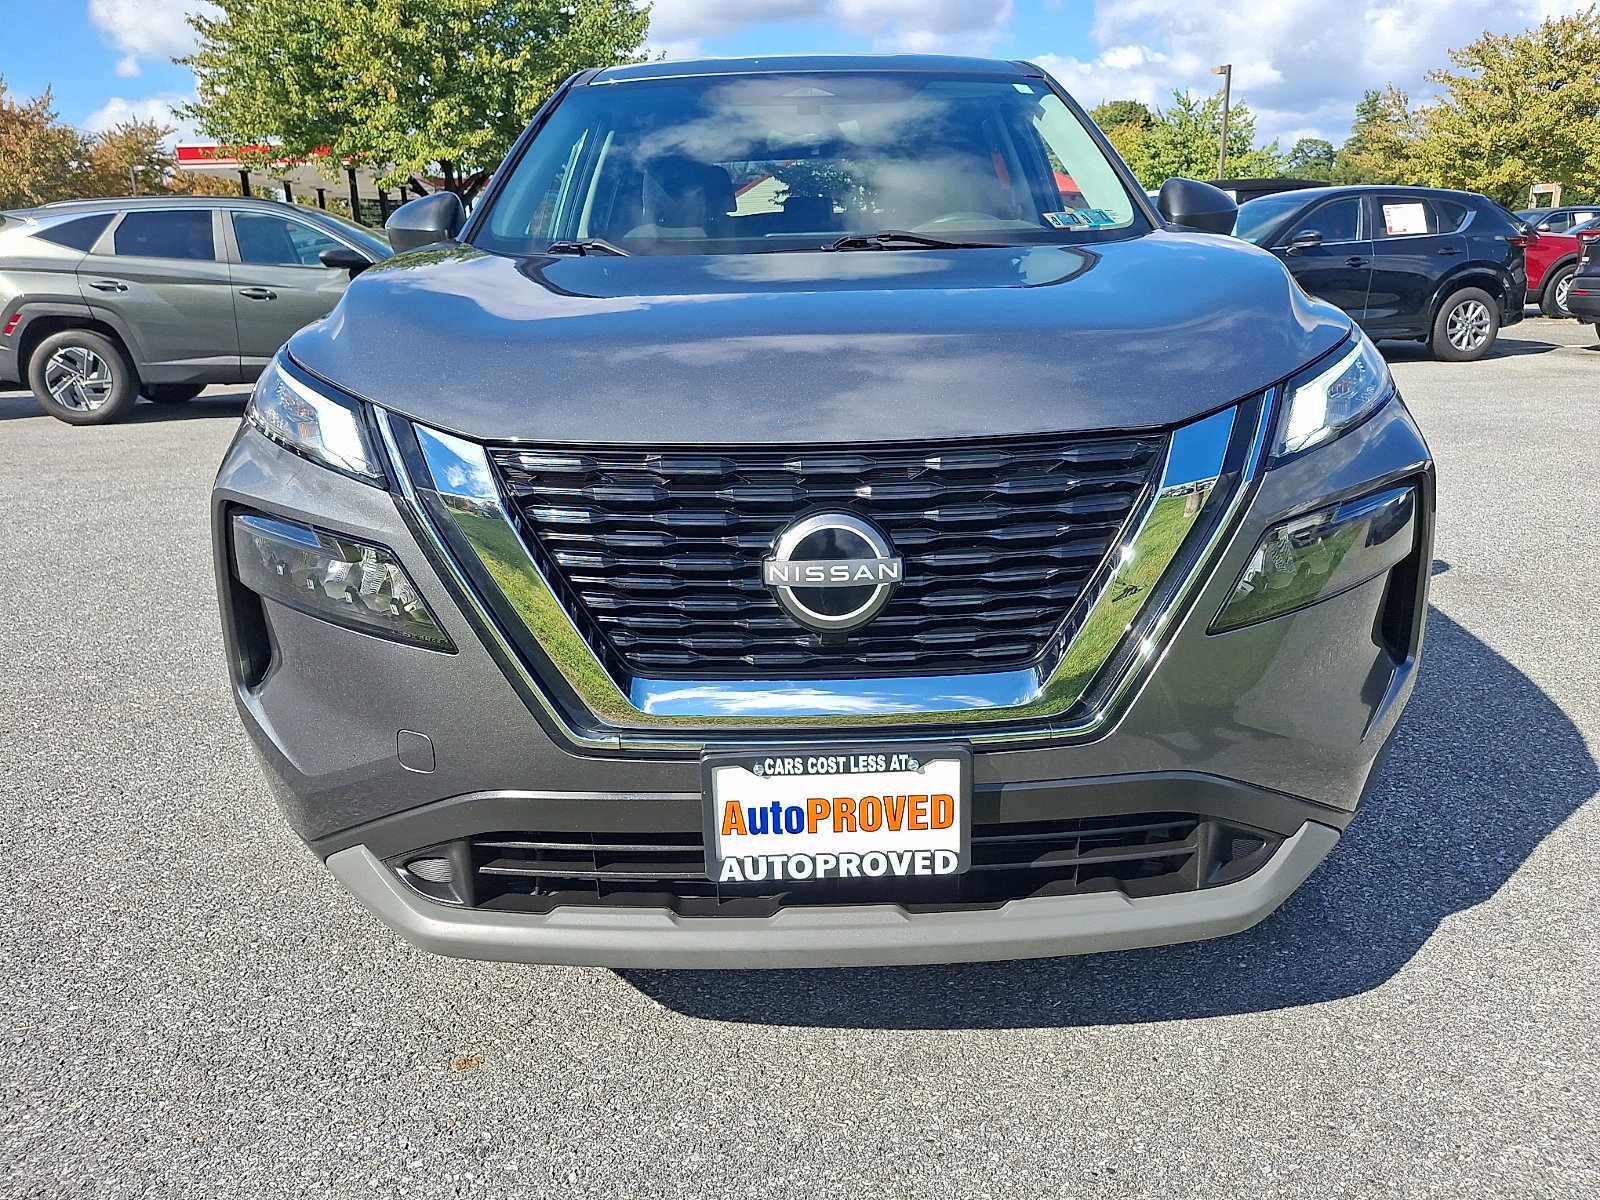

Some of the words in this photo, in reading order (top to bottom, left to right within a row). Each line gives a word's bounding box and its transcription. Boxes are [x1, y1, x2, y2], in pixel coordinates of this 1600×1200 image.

[769, 562, 898, 582] NISSAN
[764, 756, 804, 775] CARS
[807, 756, 846, 774] COST
[850, 755, 884, 773] LESS
[890, 754, 909, 771] AT
[721, 794, 955, 835] AutoPROVED
[719, 849, 958, 882] AUTOPROVED
